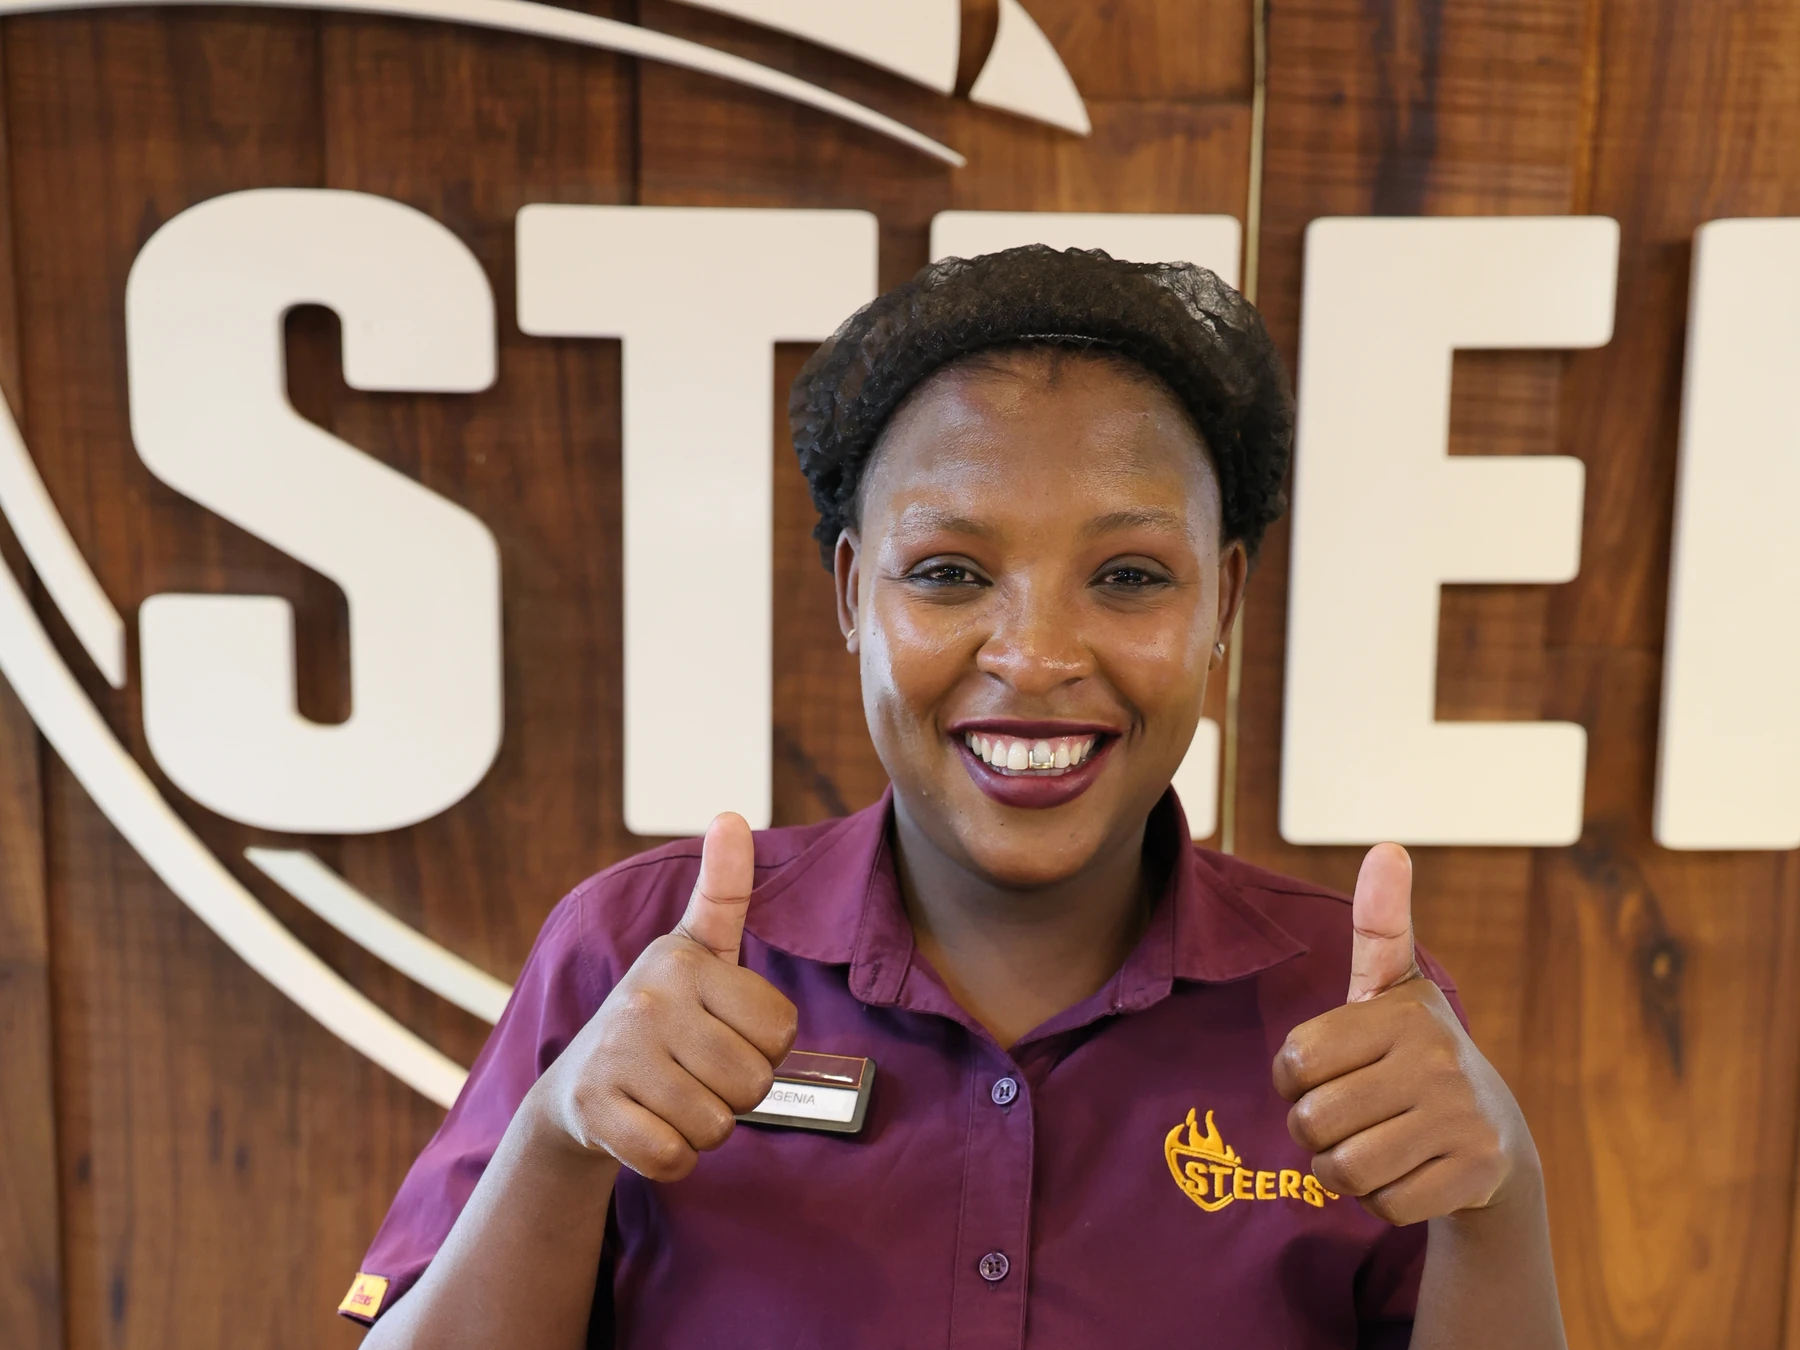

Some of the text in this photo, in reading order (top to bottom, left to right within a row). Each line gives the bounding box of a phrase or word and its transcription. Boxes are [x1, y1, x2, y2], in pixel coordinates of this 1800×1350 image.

[126, 187, 1800, 850] STE
[766, 1090, 815, 1105] UGENIA
[1185, 1161, 1325, 1208] STEERS
